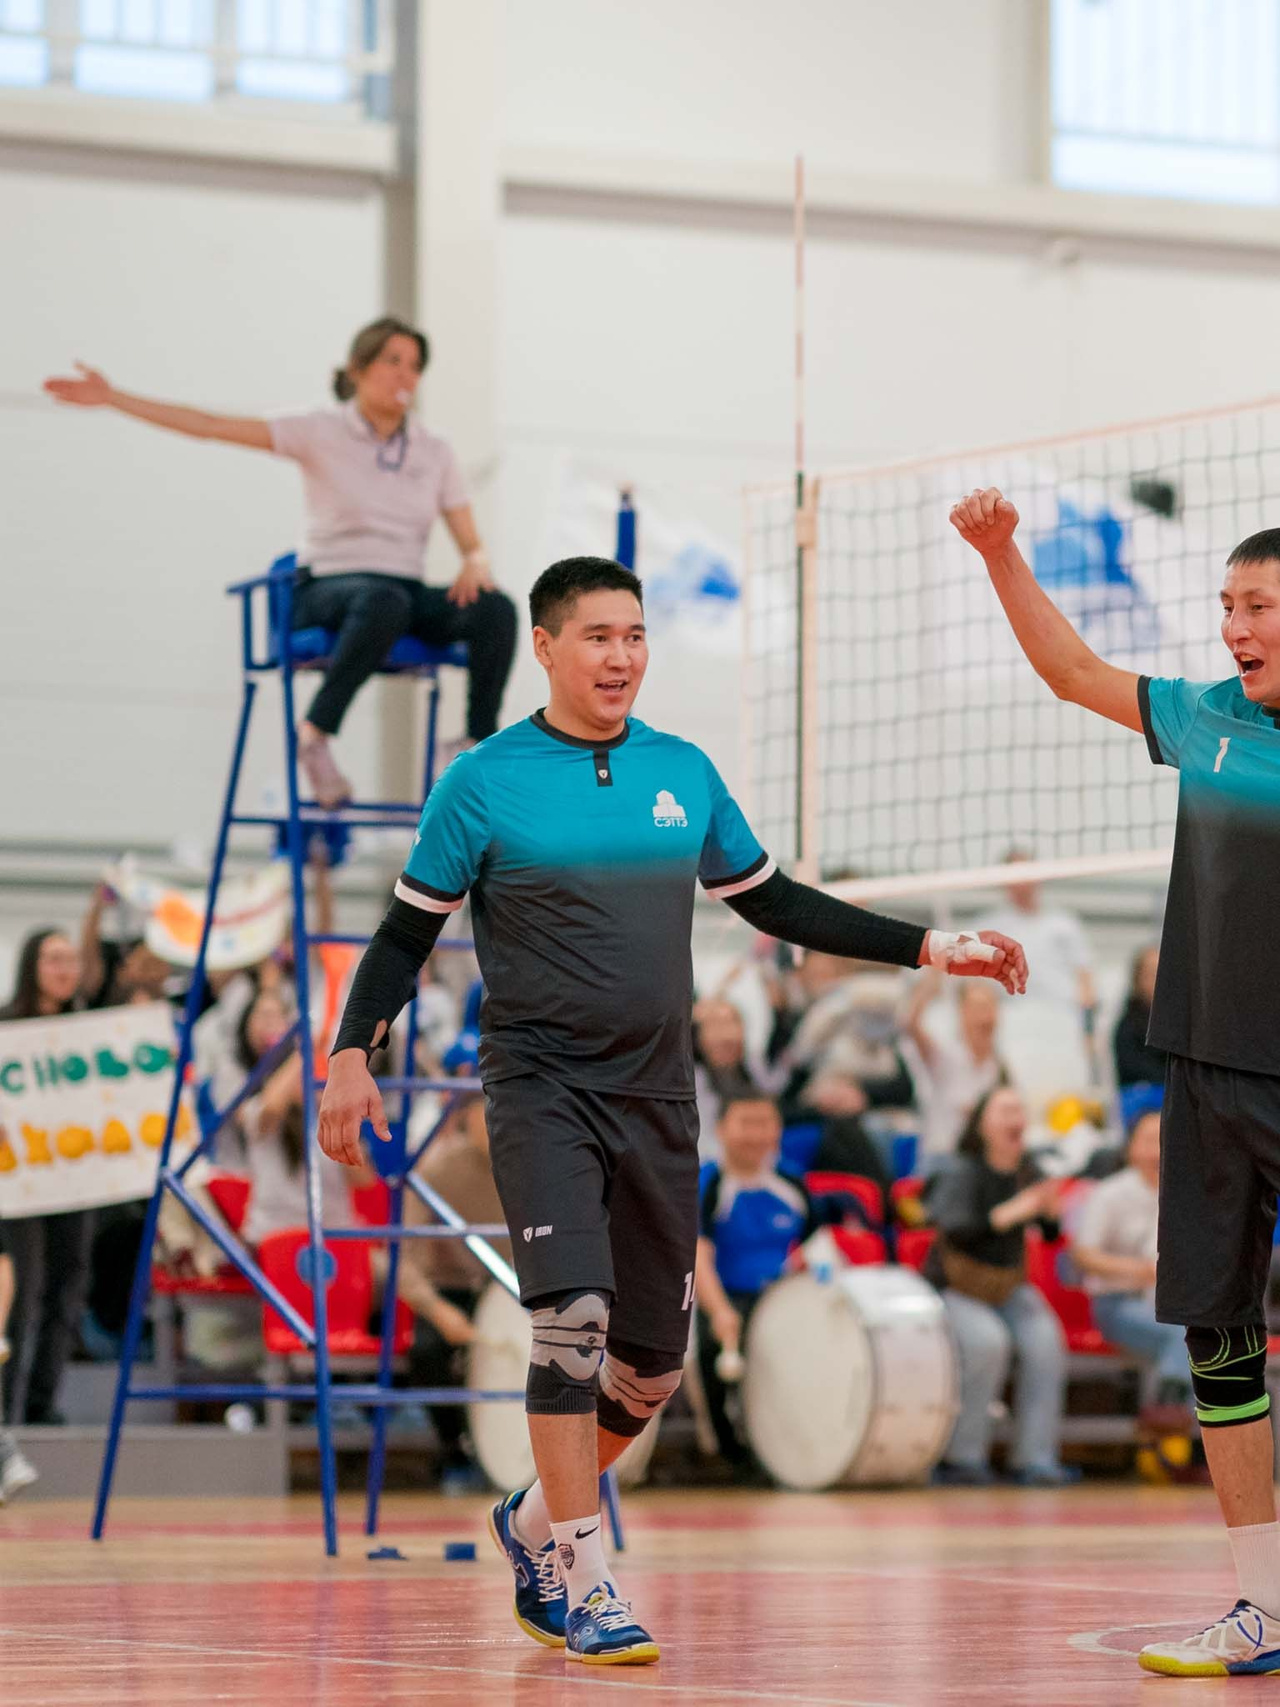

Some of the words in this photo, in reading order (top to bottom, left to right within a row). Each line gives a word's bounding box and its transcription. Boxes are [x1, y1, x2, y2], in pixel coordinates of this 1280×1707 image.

[1213, 737, 1231, 773] 1
[654, 817, 689, 828] СЭТТЭ
[681, 1271, 695, 1311] 1
